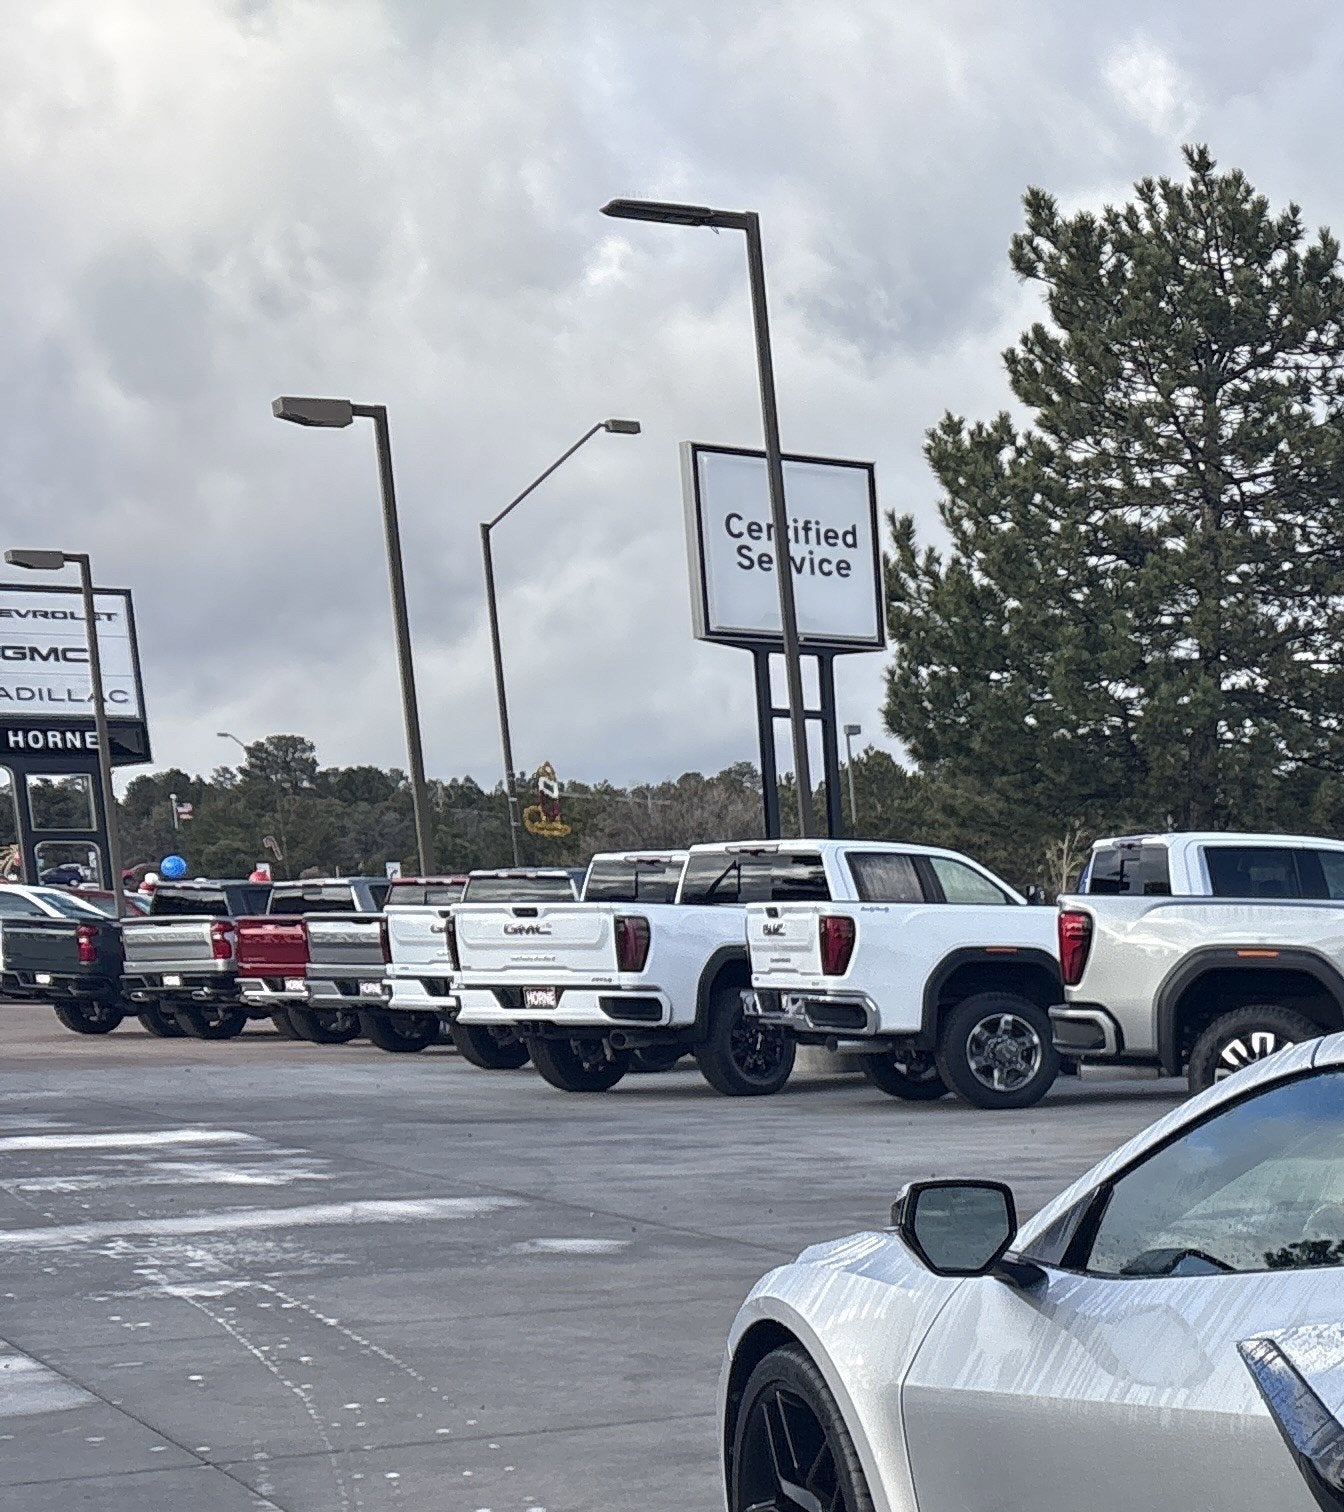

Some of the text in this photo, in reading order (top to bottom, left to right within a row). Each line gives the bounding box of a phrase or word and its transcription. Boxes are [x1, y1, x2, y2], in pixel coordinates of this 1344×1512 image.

[724, 512, 858, 549] Cerified
[736, 544, 852, 578] Sevice
[0, 645, 90, 663] GMC
[7, 730, 100, 749] HORNE
[503, 923, 552, 935] GMC
